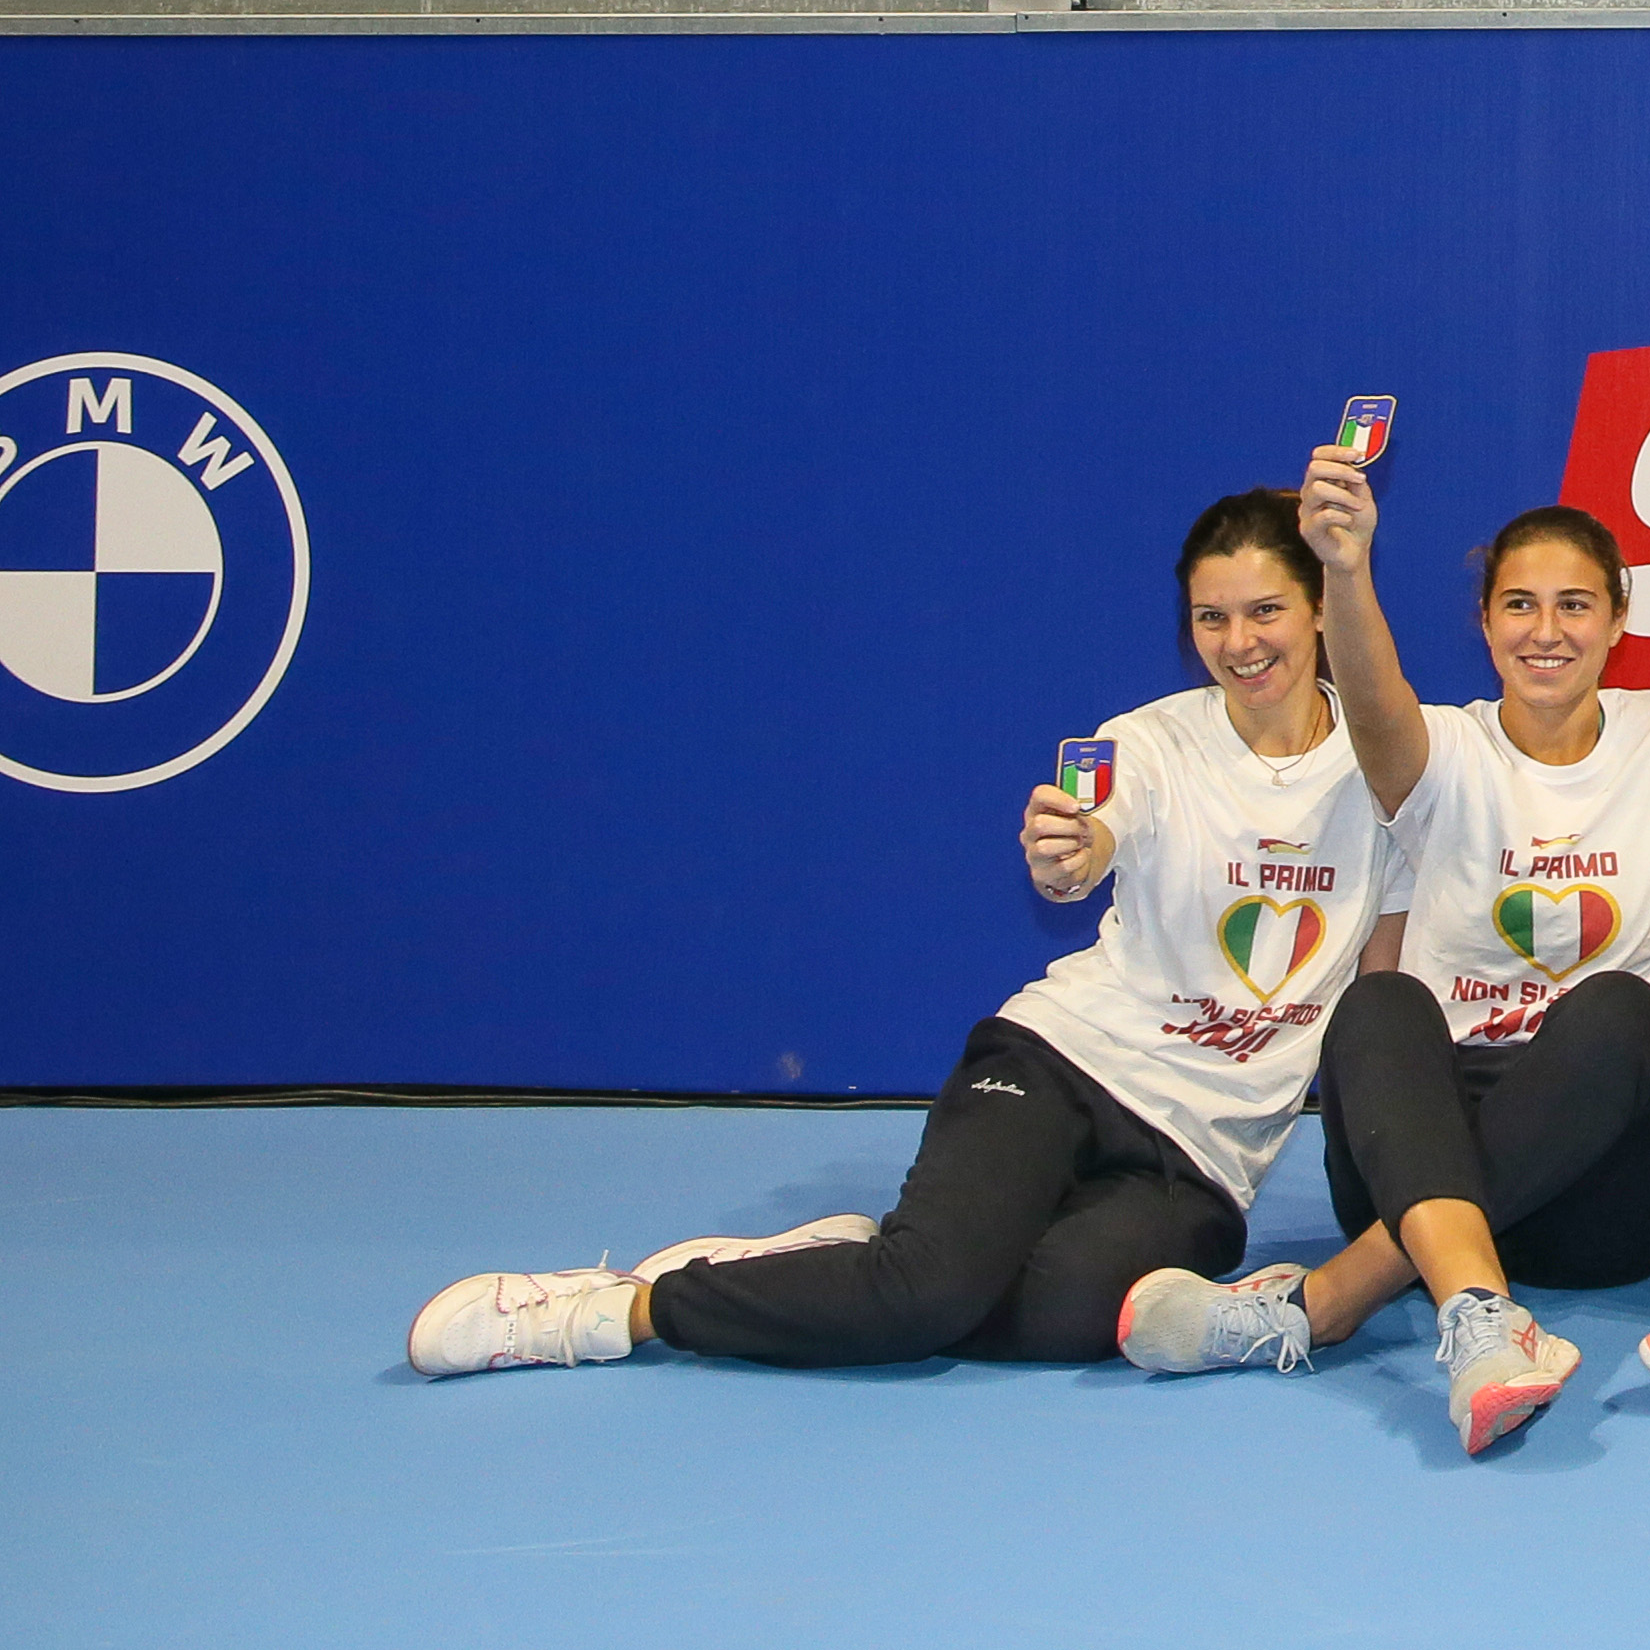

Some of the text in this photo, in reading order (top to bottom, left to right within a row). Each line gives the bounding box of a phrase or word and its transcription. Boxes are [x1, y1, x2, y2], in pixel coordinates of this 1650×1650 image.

[1228, 862, 1335, 892] IL PRIMO
[1500, 849, 1618, 879] IL PRIMO
[1451, 976, 1510, 1002] NON
[1520, 981, 1548, 1005] SI
